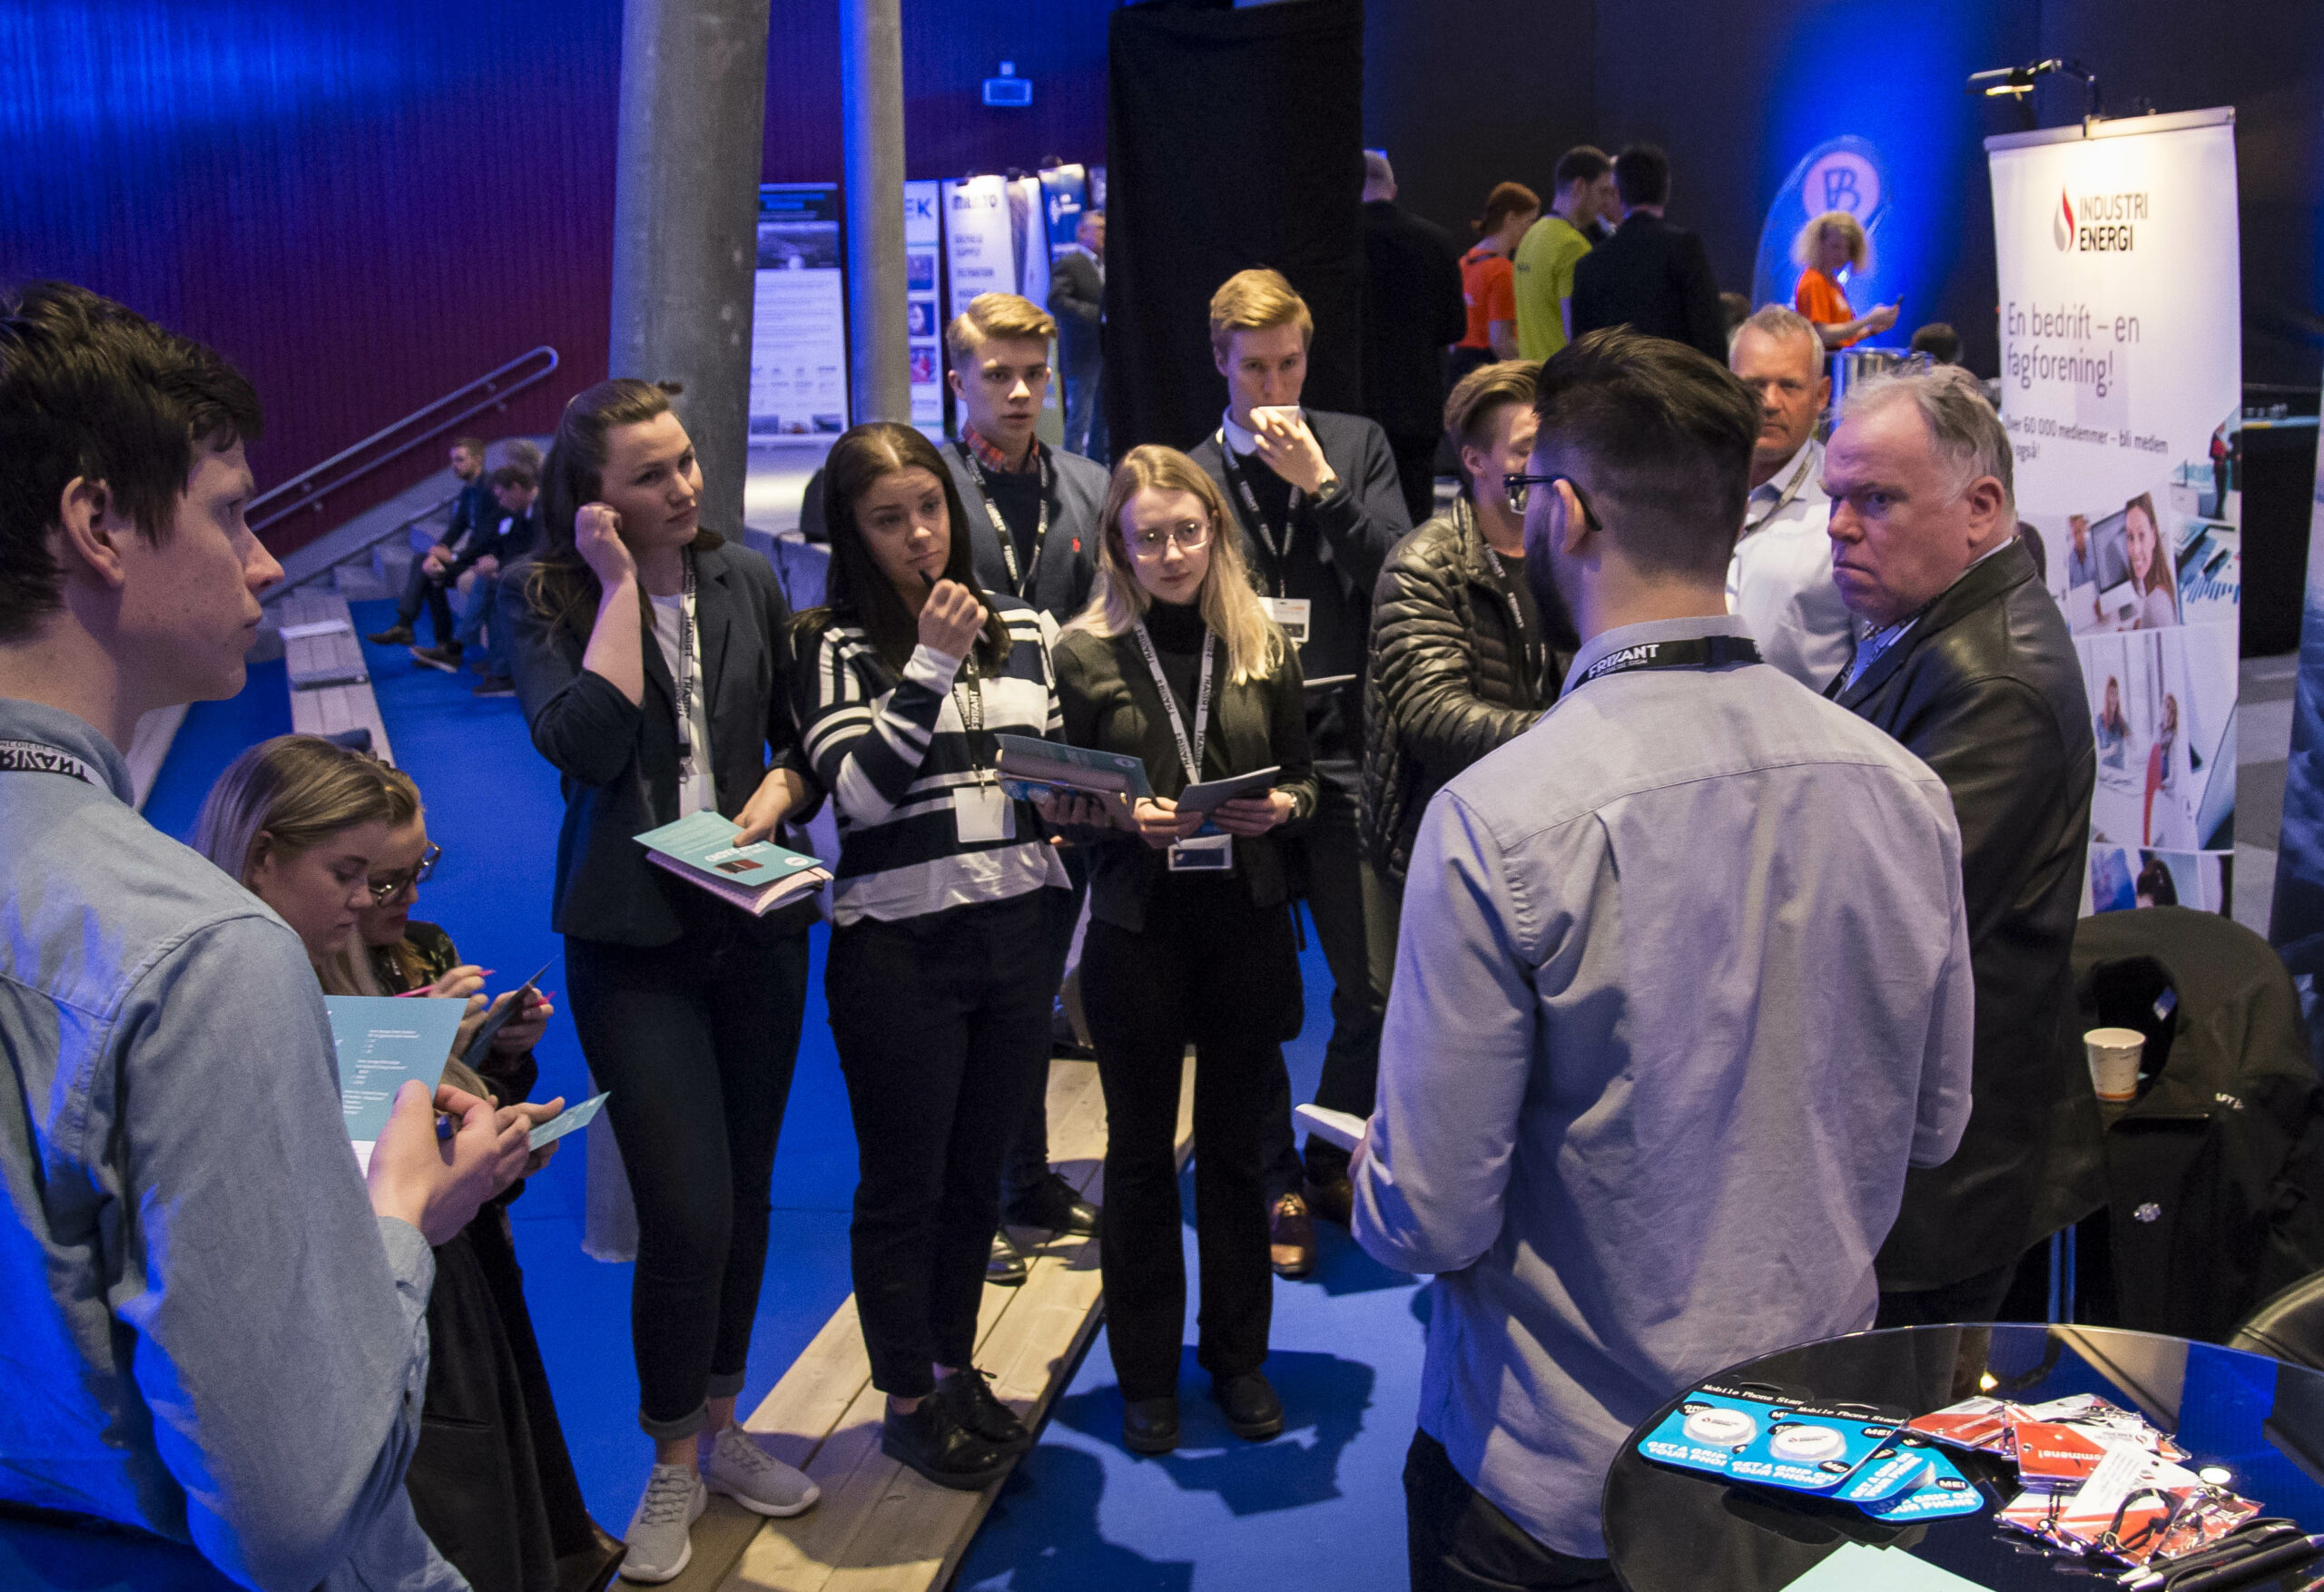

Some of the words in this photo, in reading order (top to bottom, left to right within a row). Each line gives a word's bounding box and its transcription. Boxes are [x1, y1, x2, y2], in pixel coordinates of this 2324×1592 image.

[2080, 192, 2148, 221] INDUSTRI
[2080, 225, 2133, 251] ENERGI
[2008, 301, 2025, 336] En
[2032, 302, 2092, 340] bedrift
[2115, 315, 2140, 342] en
[2007, 341, 2113, 398] fagforening!
[2024, 417, 2036, 433] 60
[1702, 1384, 1740, 1396] Mobile
[1742, 1391, 1774, 1401] Phone
[1775, 1397, 1807, 1406] Stan
[1797, 1406, 1835, 1416] Mobile
[1837, 1410, 1868, 1420] Phone
[1871, 1415, 1905, 1425] Stand
[1864, 1428, 1891, 1437] ME!
[1938, 1479, 1967, 1489] ME!
